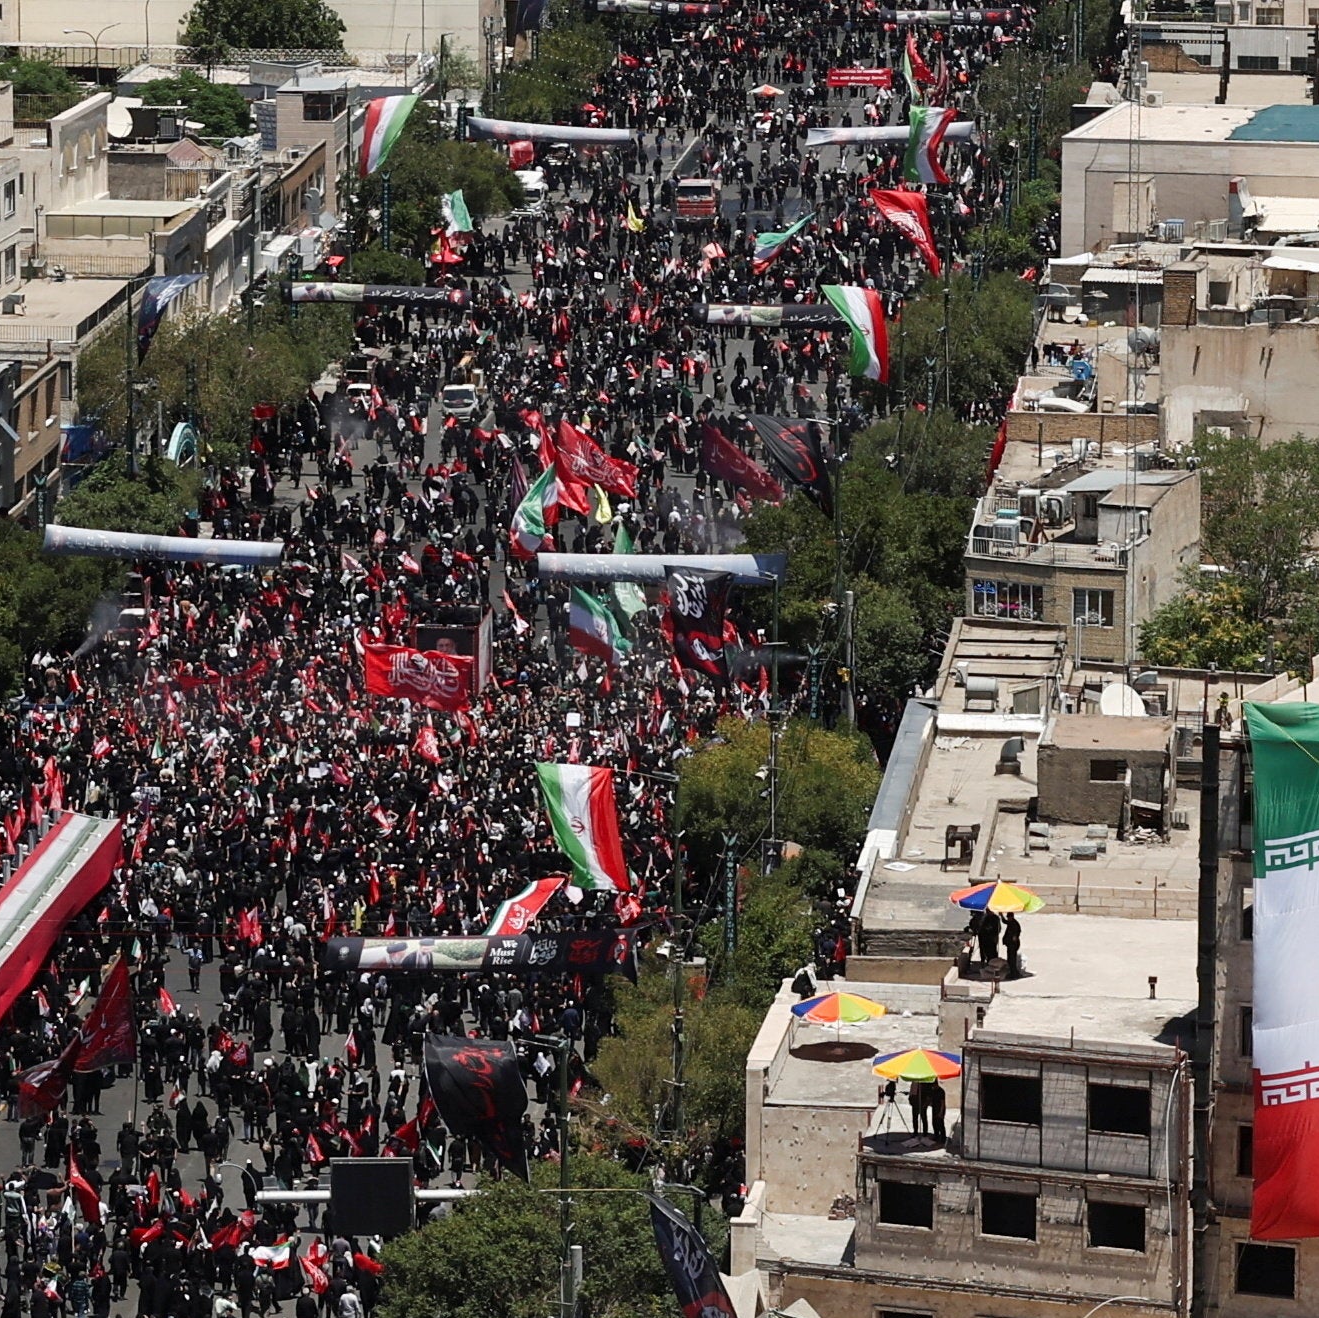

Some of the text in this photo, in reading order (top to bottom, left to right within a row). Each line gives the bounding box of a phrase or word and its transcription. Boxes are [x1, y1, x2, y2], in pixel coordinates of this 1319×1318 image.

[501, 939, 519, 949] We
[489, 948, 516, 958] Must
[492, 956, 513, 966] Rise
